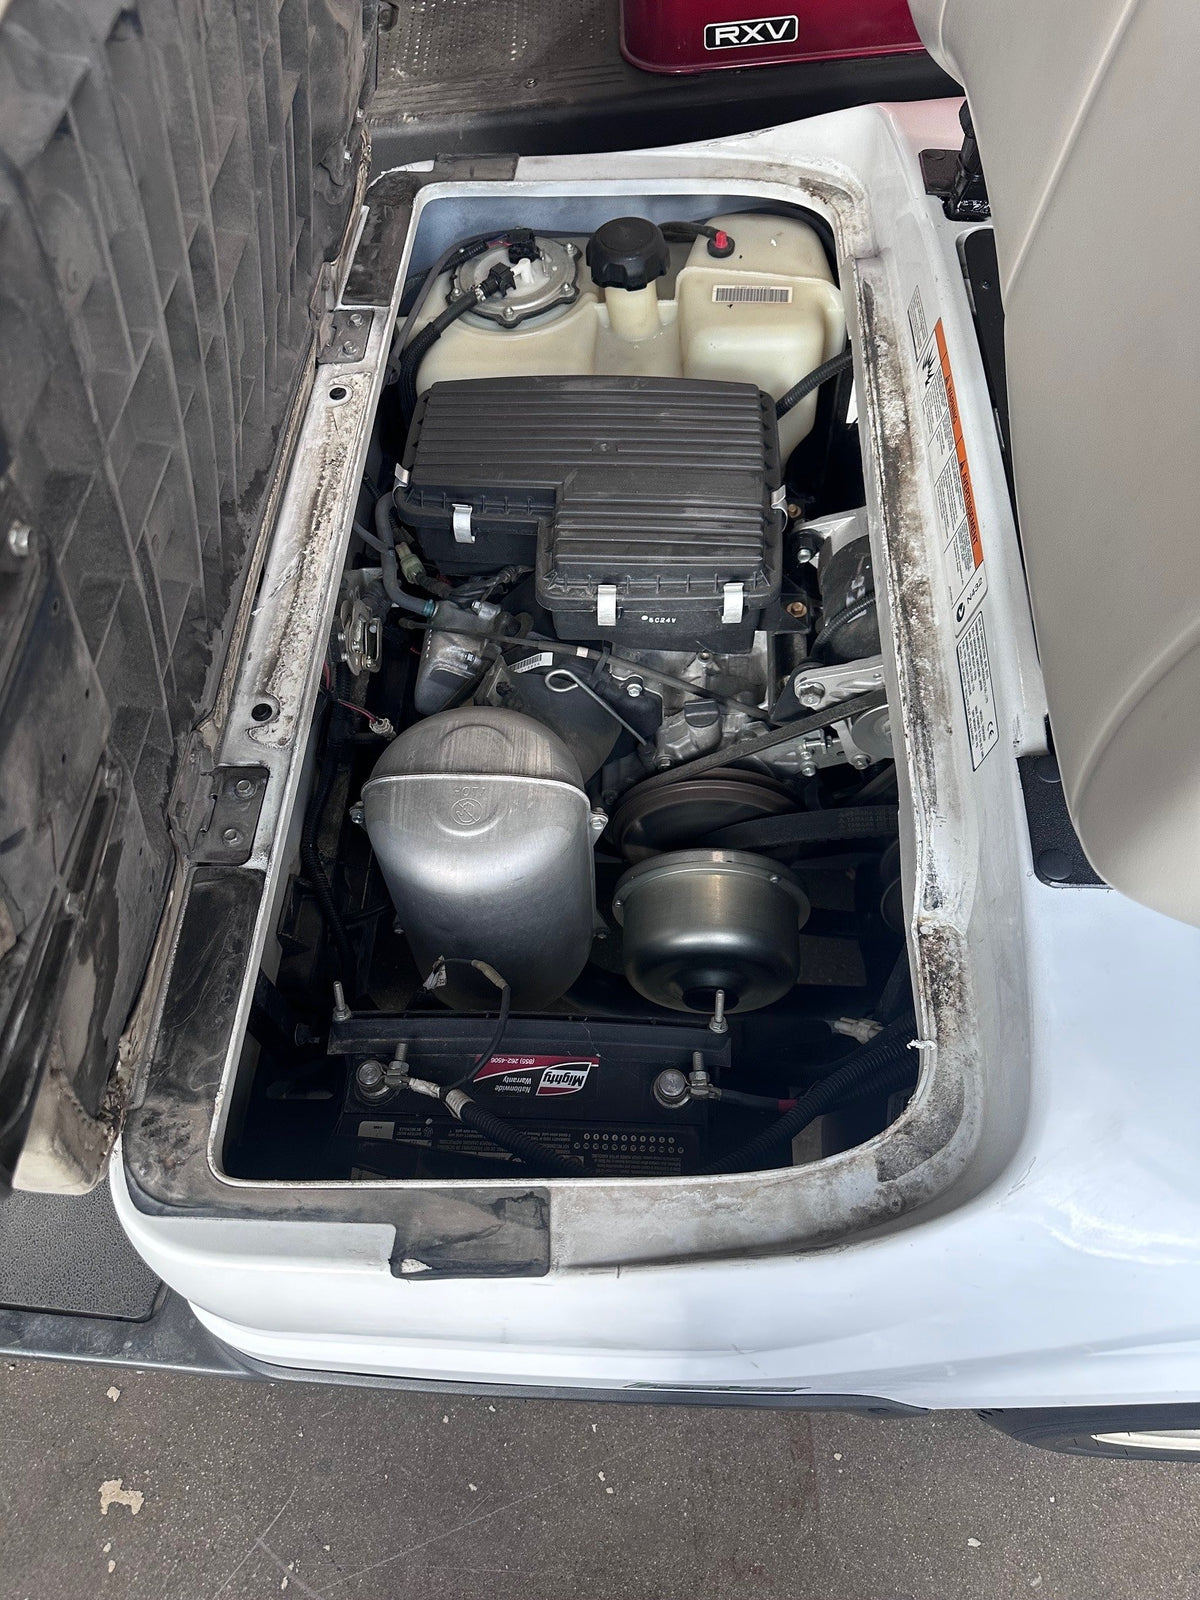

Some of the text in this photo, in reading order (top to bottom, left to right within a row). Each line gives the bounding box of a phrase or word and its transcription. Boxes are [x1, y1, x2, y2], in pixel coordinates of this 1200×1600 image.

[715, 20, 790, 45] RXV
[947, 386, 958, 425] WARNING
[961, 472, 978, 546] AVERTISSEMENT
[494, 1085, 531, 1093] Nationwide
[502, 1075, 532, 1085] Warranty
[543, 1071, 585, 1087] Mighty
